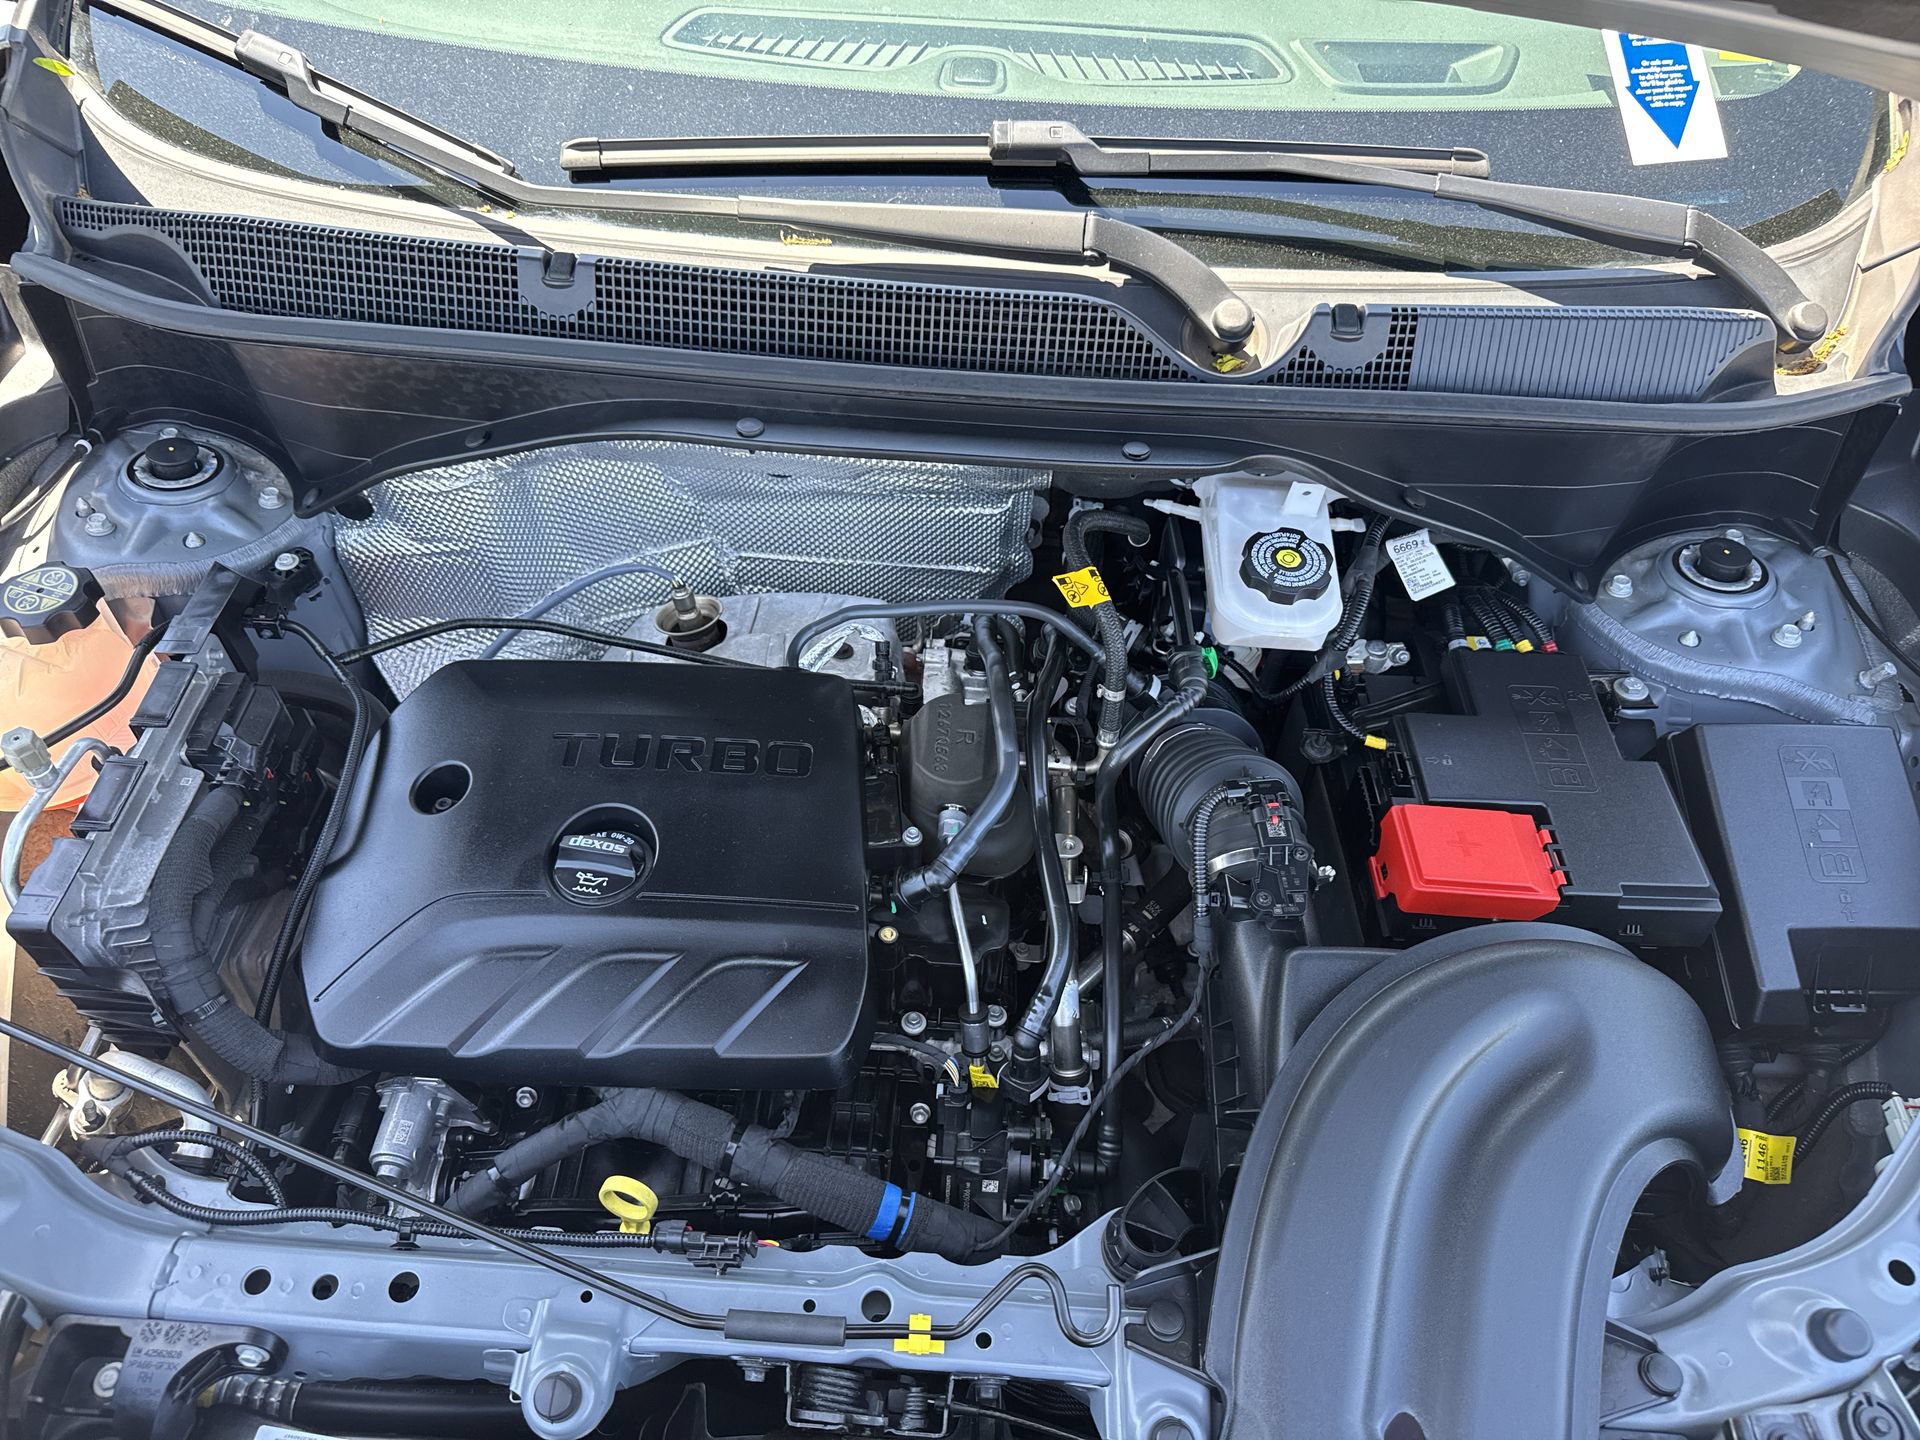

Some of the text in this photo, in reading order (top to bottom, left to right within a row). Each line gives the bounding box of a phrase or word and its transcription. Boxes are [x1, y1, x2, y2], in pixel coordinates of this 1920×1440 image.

[1393, 539, 1419, 554] 6669
[956, 729, 976, 744] R
[552, 732, 814, 778] TURBO
[568, 835, 628, 854] dexos
[610, 832, 635, 845] 0W-20
[1756, 1142, 1767, 1170] 1146
